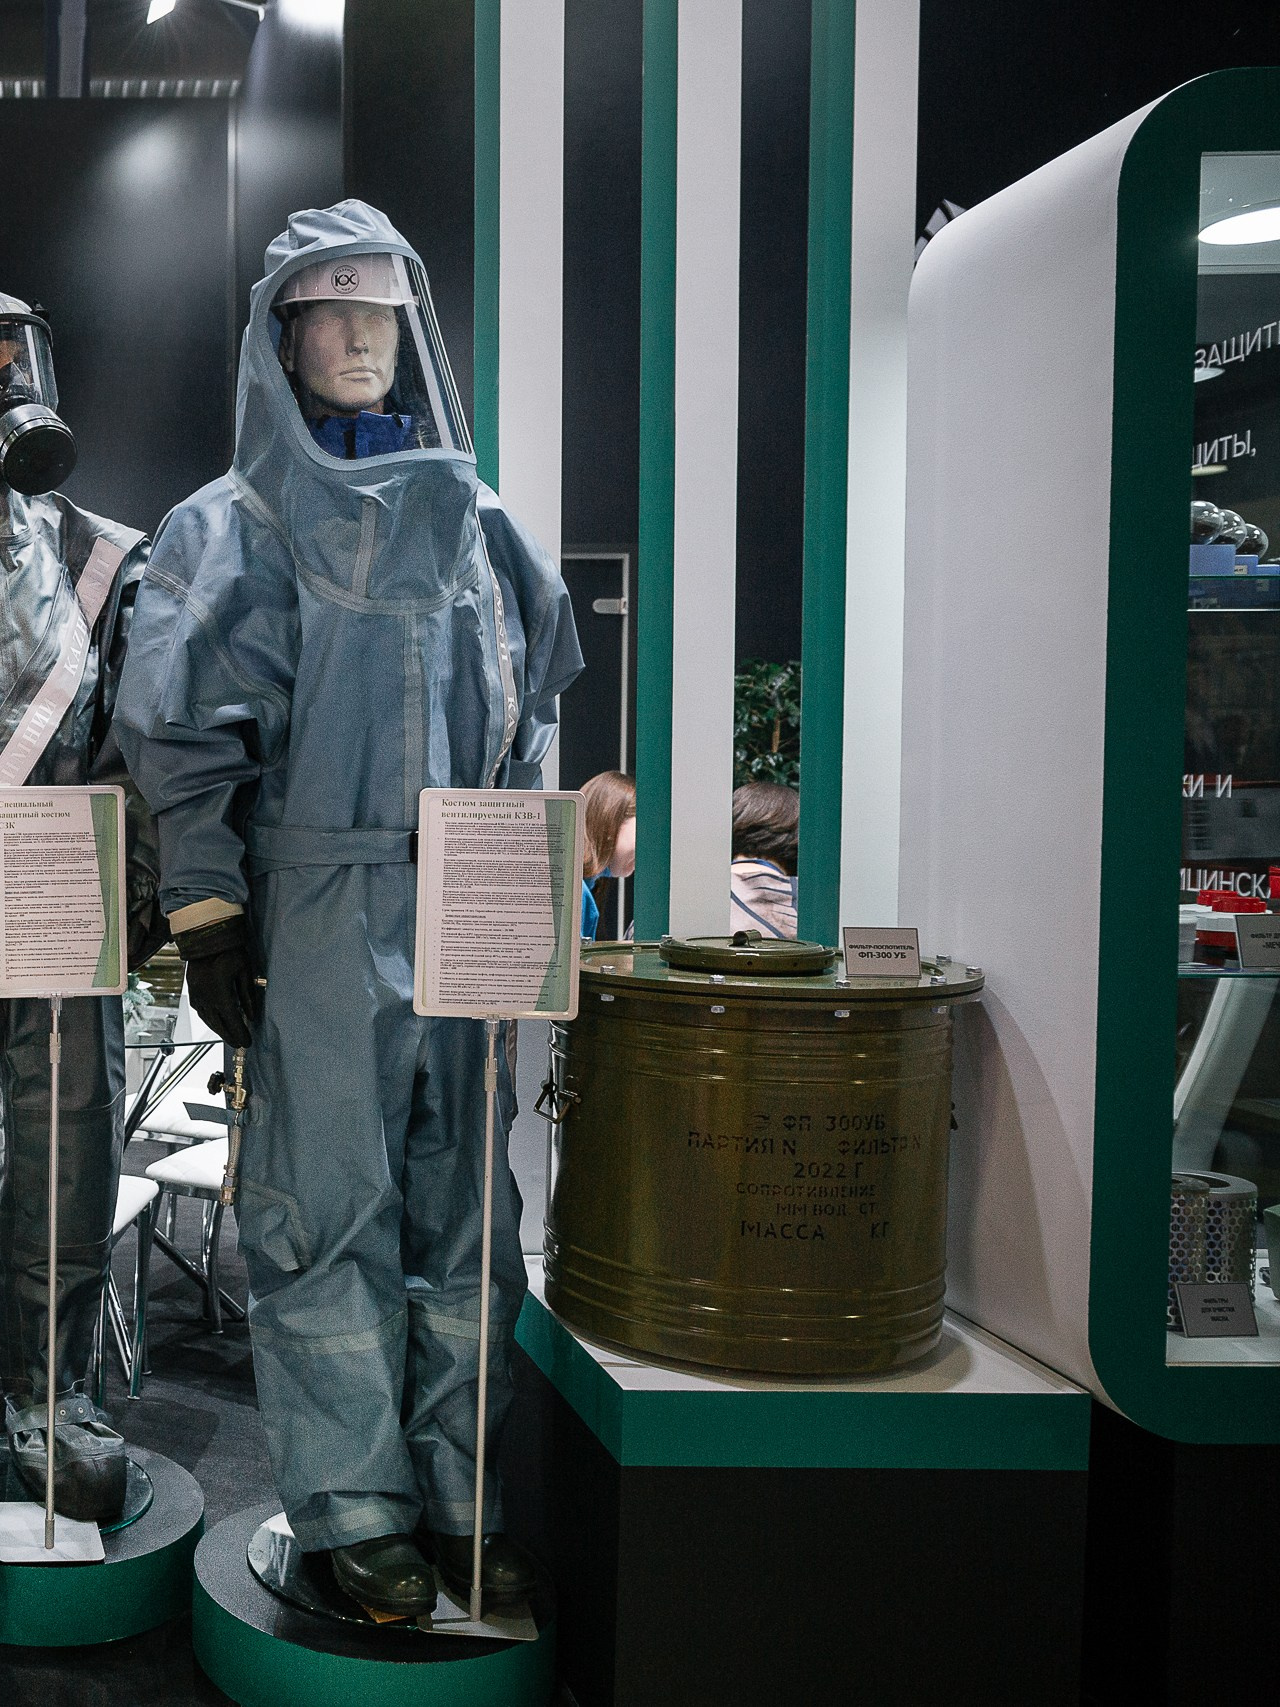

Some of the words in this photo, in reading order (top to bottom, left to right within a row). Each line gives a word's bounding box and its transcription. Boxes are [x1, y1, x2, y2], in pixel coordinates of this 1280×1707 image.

[1194, 320, 1280, 369] ЗАЩИТ
[442, 798, 476, 807] Костюм
[441, 812, 512, 821] вентилируемый
[514, 811, 541, 820] КЗВ-1
[858, 951, 892, 959] ФП-300
[782, 1114, 812, 1132] ФП
[687, 1131, 774, 1155] ПАРТИЯ
[793, 1162, 847, 1179] 2022
[740, 1221, 826, 1241] МАССА
[870, 1221, 891, 1239] КГ
